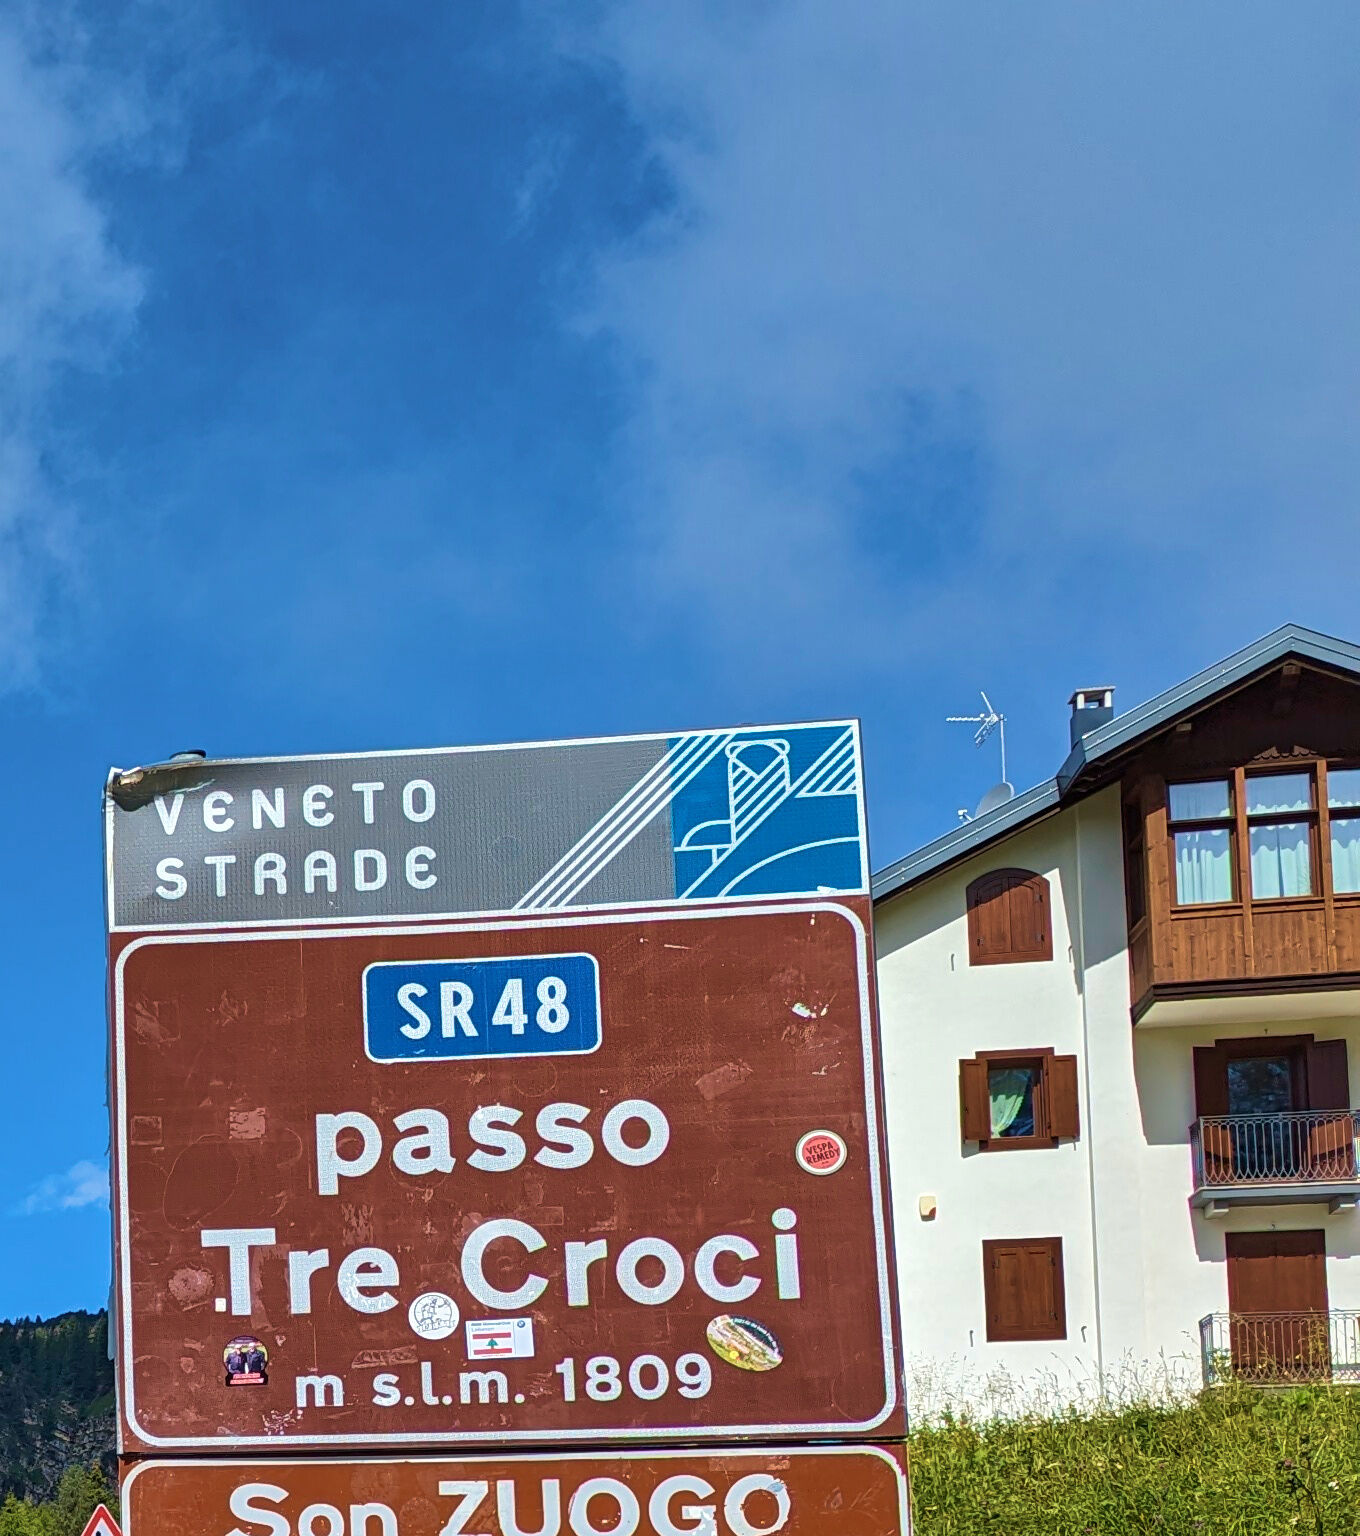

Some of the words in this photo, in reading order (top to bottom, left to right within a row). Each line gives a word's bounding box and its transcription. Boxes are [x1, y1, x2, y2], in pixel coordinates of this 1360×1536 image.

[154, 779, 436, 835] VENETO
[155, 846, 438, 899] STRADE
[396, 981, 479, 1039] SR
[492, 976, 570, 1035] 48
[315, 1099, 670, 1195] passo
[805, 1147, 841, 1165] REMEDY
[806, 1141, 834, 1155] VESPA
[201, 1227, 400, 1316] Tre
[460, 1208, 801, 1310] Croci
[295, 1373, 344, 1408] m
[372, 1361, 526, 1406] s.l.m.
[555, 1353, 712, 1401] 1809
